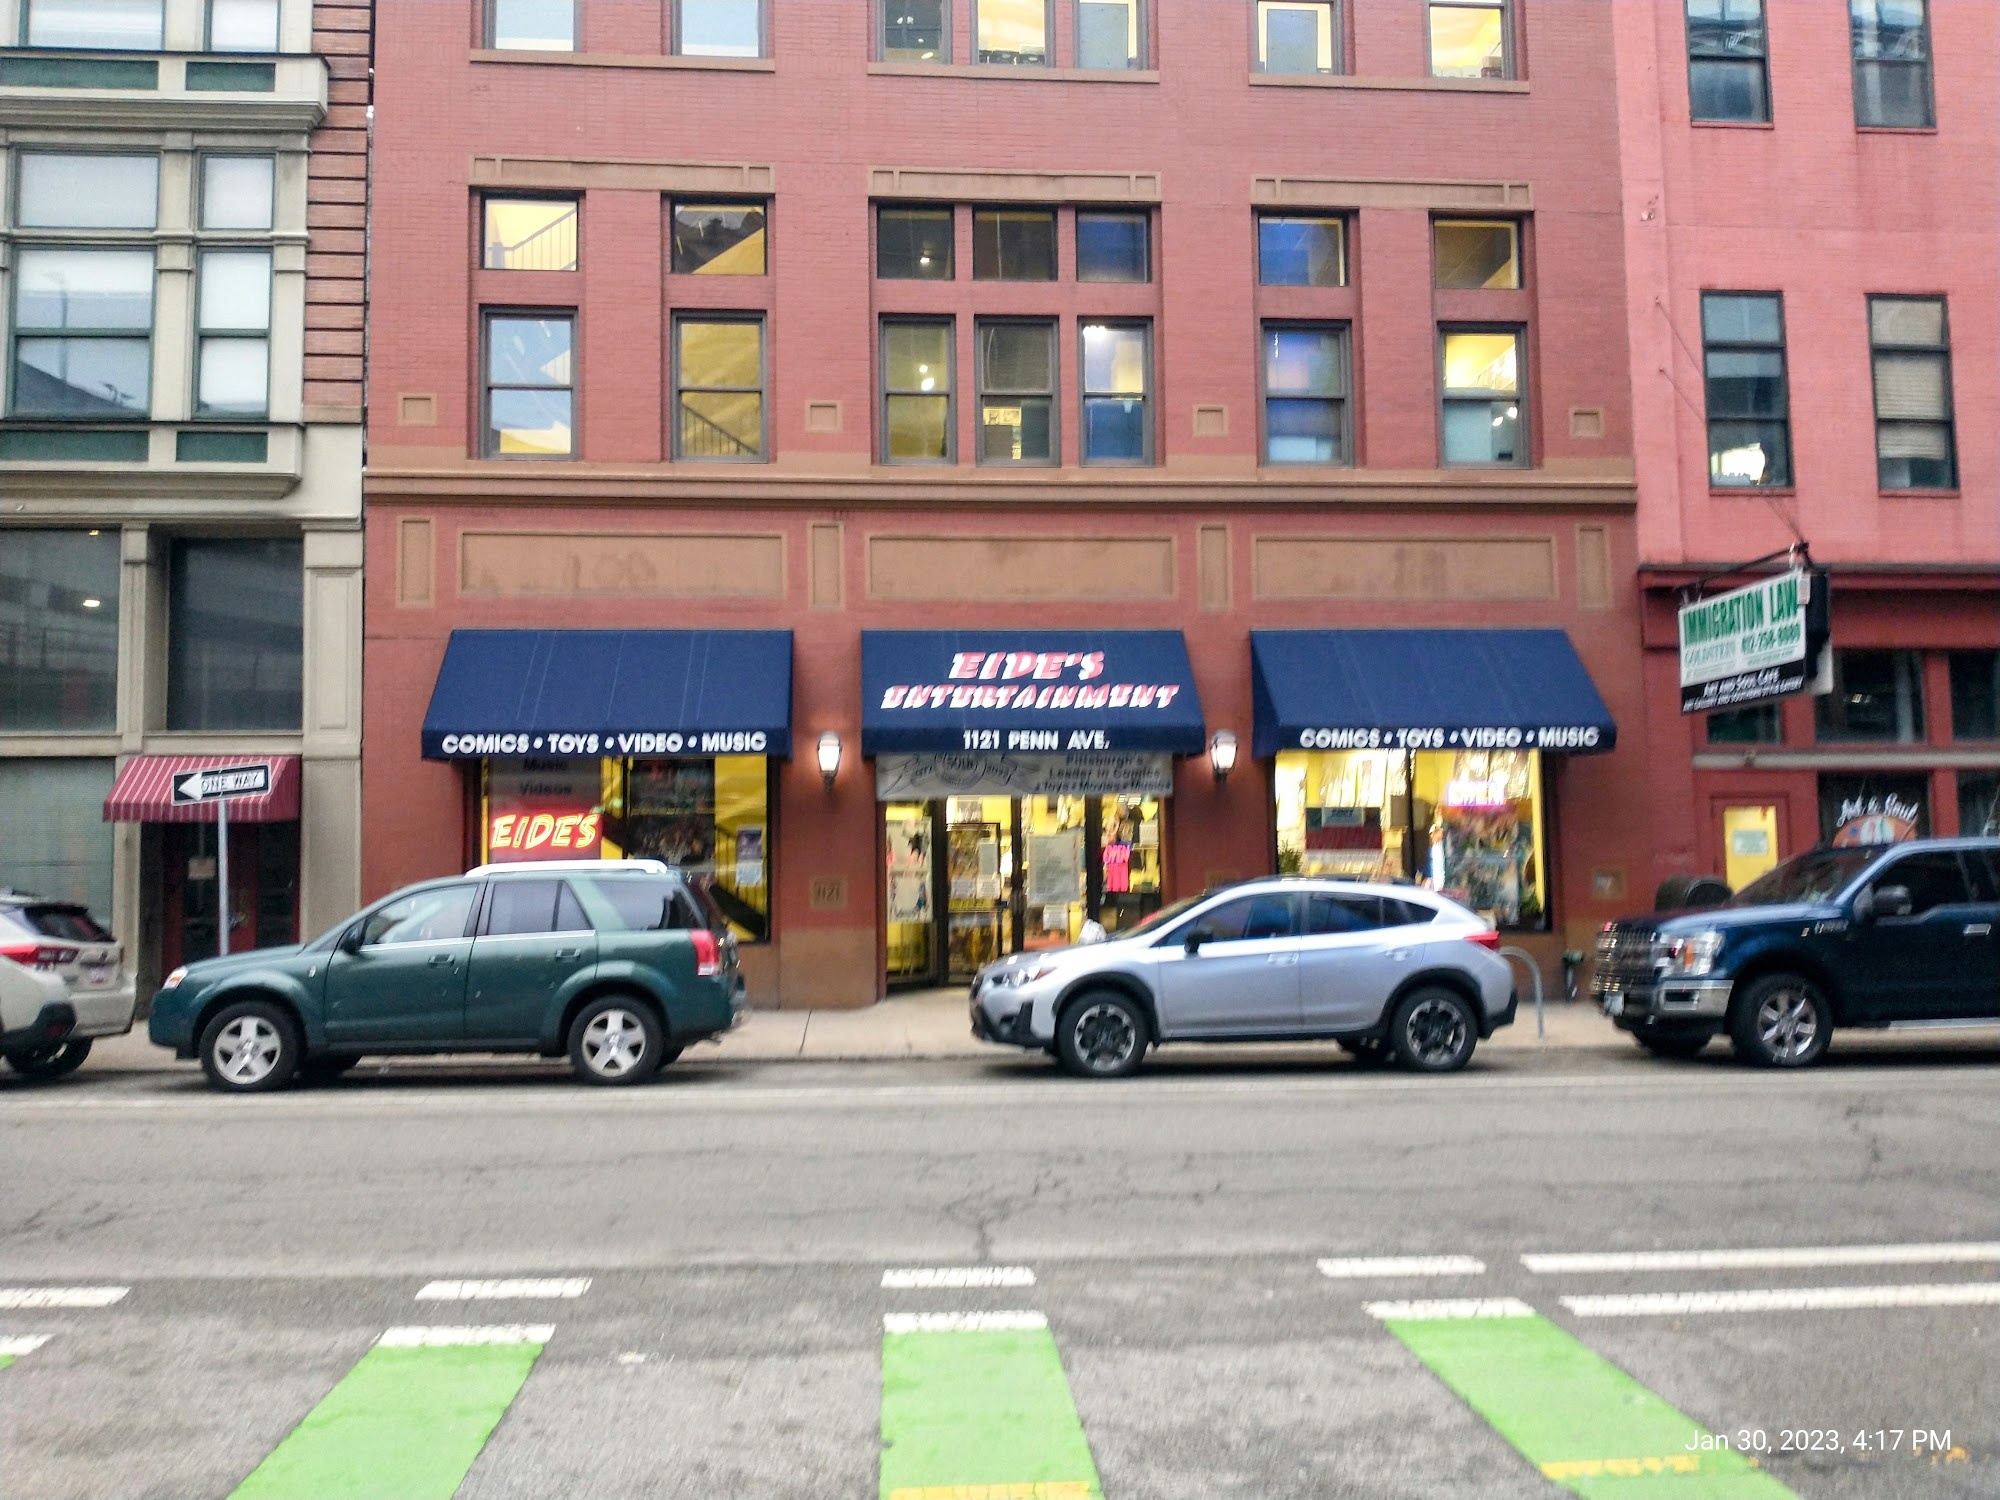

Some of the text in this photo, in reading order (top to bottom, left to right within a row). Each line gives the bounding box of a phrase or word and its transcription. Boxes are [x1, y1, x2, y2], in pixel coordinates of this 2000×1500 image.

[1684, 577, 1798, 646] IMMIGRATION LAW
[948, 651, 1104, 680] EIDE'S
[881, 684, 1180, 709] ENTERTAINMENT
[442, 731, 767, 754] COMICS TOYS VIDEO MUSIC
[963, 730, 1000, 749] 1121
[1008, 730, 1059, 749] PENN
[1300, 726, 1599, 748] COMICS TOYS VIDEO MUSIC
[201, 772, 259, 792] ONE WAY
[492, 813, 599, 850] EIDE'S
